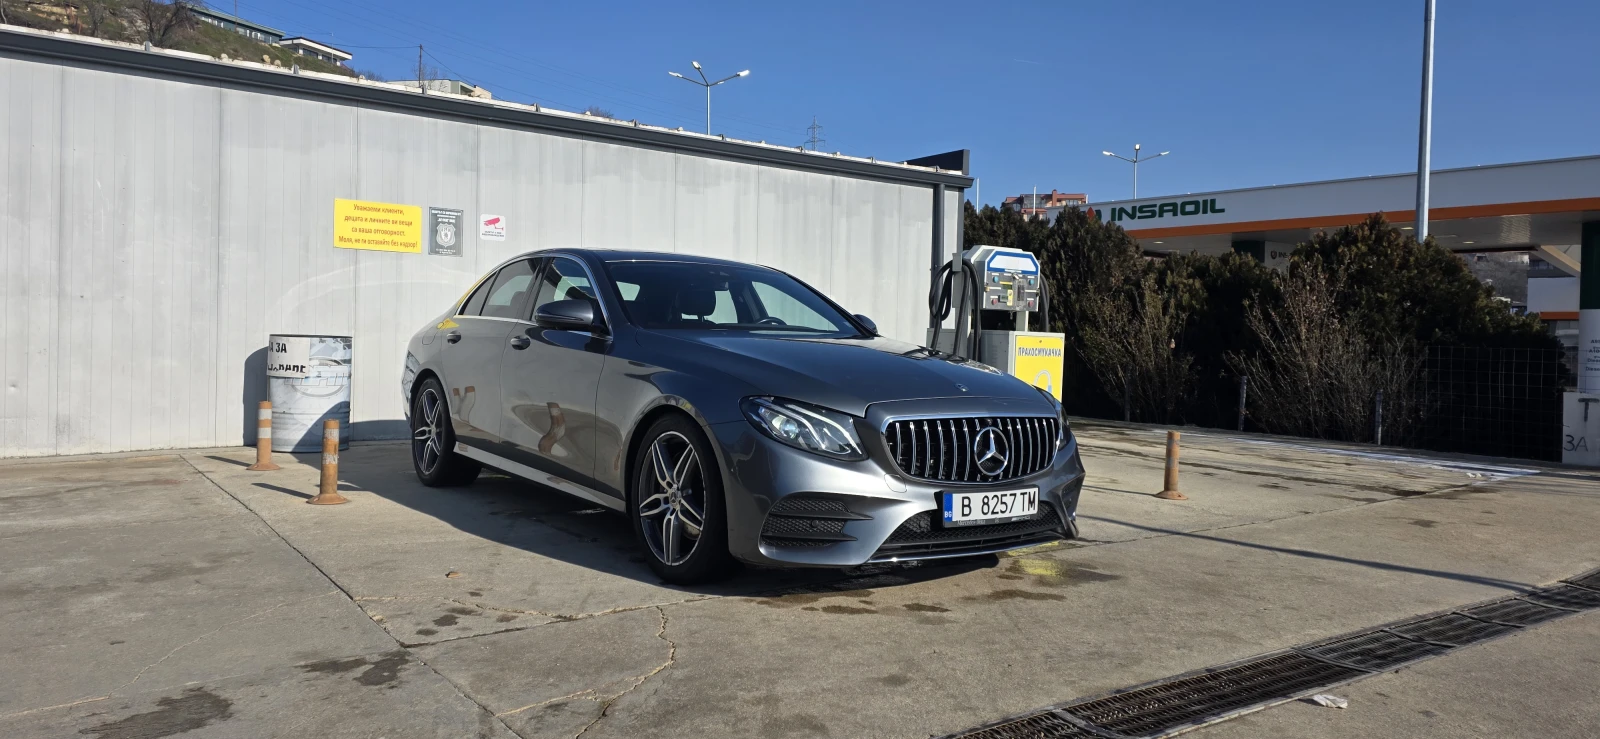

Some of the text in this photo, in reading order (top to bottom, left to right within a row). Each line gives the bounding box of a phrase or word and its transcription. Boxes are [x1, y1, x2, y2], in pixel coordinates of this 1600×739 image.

[353, 204, 405, 216] Уважаеми клиенти,
[1110, 198, 1226, 222] INSAOIL
[344, 215, 364, 223] децата
[369, 217, 391, 225] личните
[338, 235, 353, 244] Моля,
[391, 239, 399, 247] без
[1018, 347, 1062, 357] ПРАХОСМУКАЧКА
[981, 493, 1017, 515] 8257
[1020, 490, 1036, 512] TM
